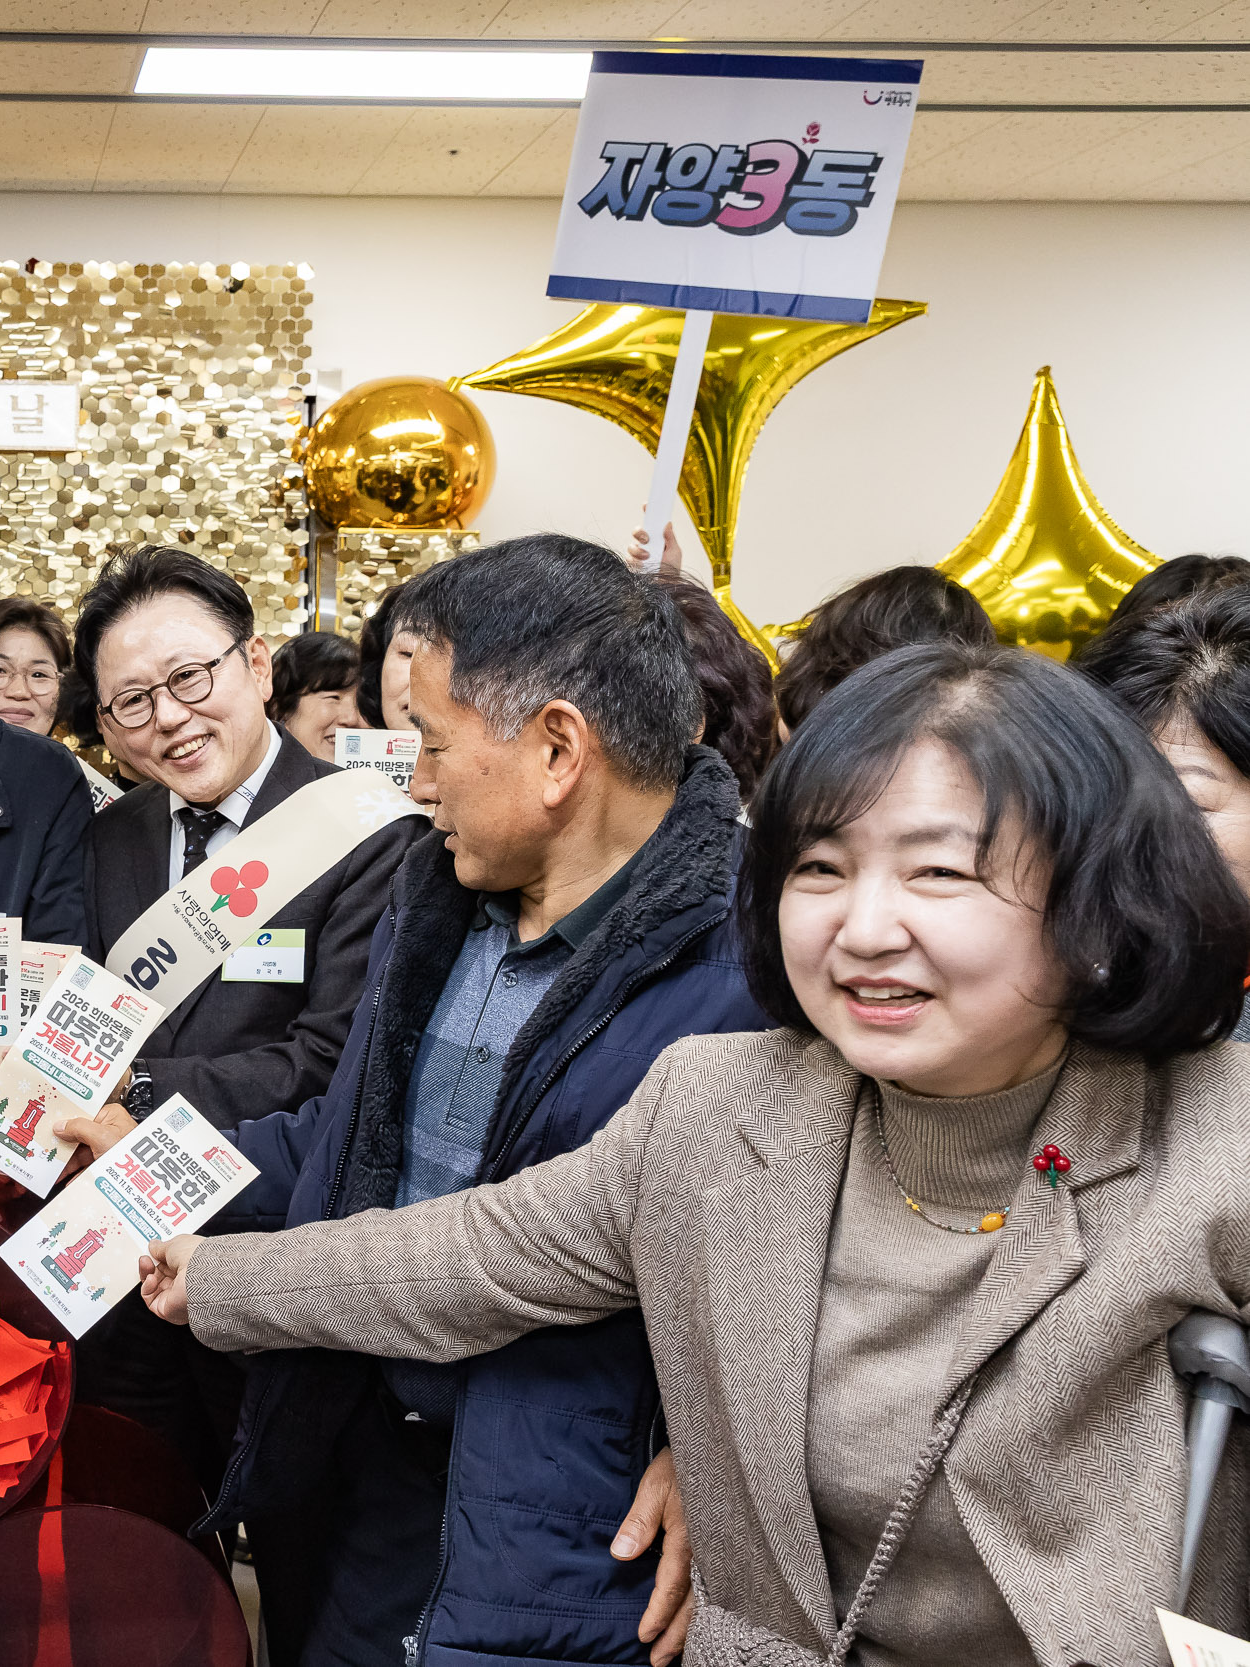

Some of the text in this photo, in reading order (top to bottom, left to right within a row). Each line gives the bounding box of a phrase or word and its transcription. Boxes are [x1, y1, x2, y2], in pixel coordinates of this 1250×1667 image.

[578, 139, 884, 236] 자양3동
[10, 393, 49, 434] 날
[178, 890, 231, 951] 사랑의열매
[47, 1001, 124, 1062] 따뜻한
[62, 990, 90, 1012] 2026
[89, 1008, 133, 1041] 희망온돌
[36, 1022, 110, 1078] 겨울나기
[115, 1154, 187, 1227] 겨울나기
[131, 1136, 207, 1212] 따뜻한
[152, 1128, 220, 1195] 2026 희망온돌
